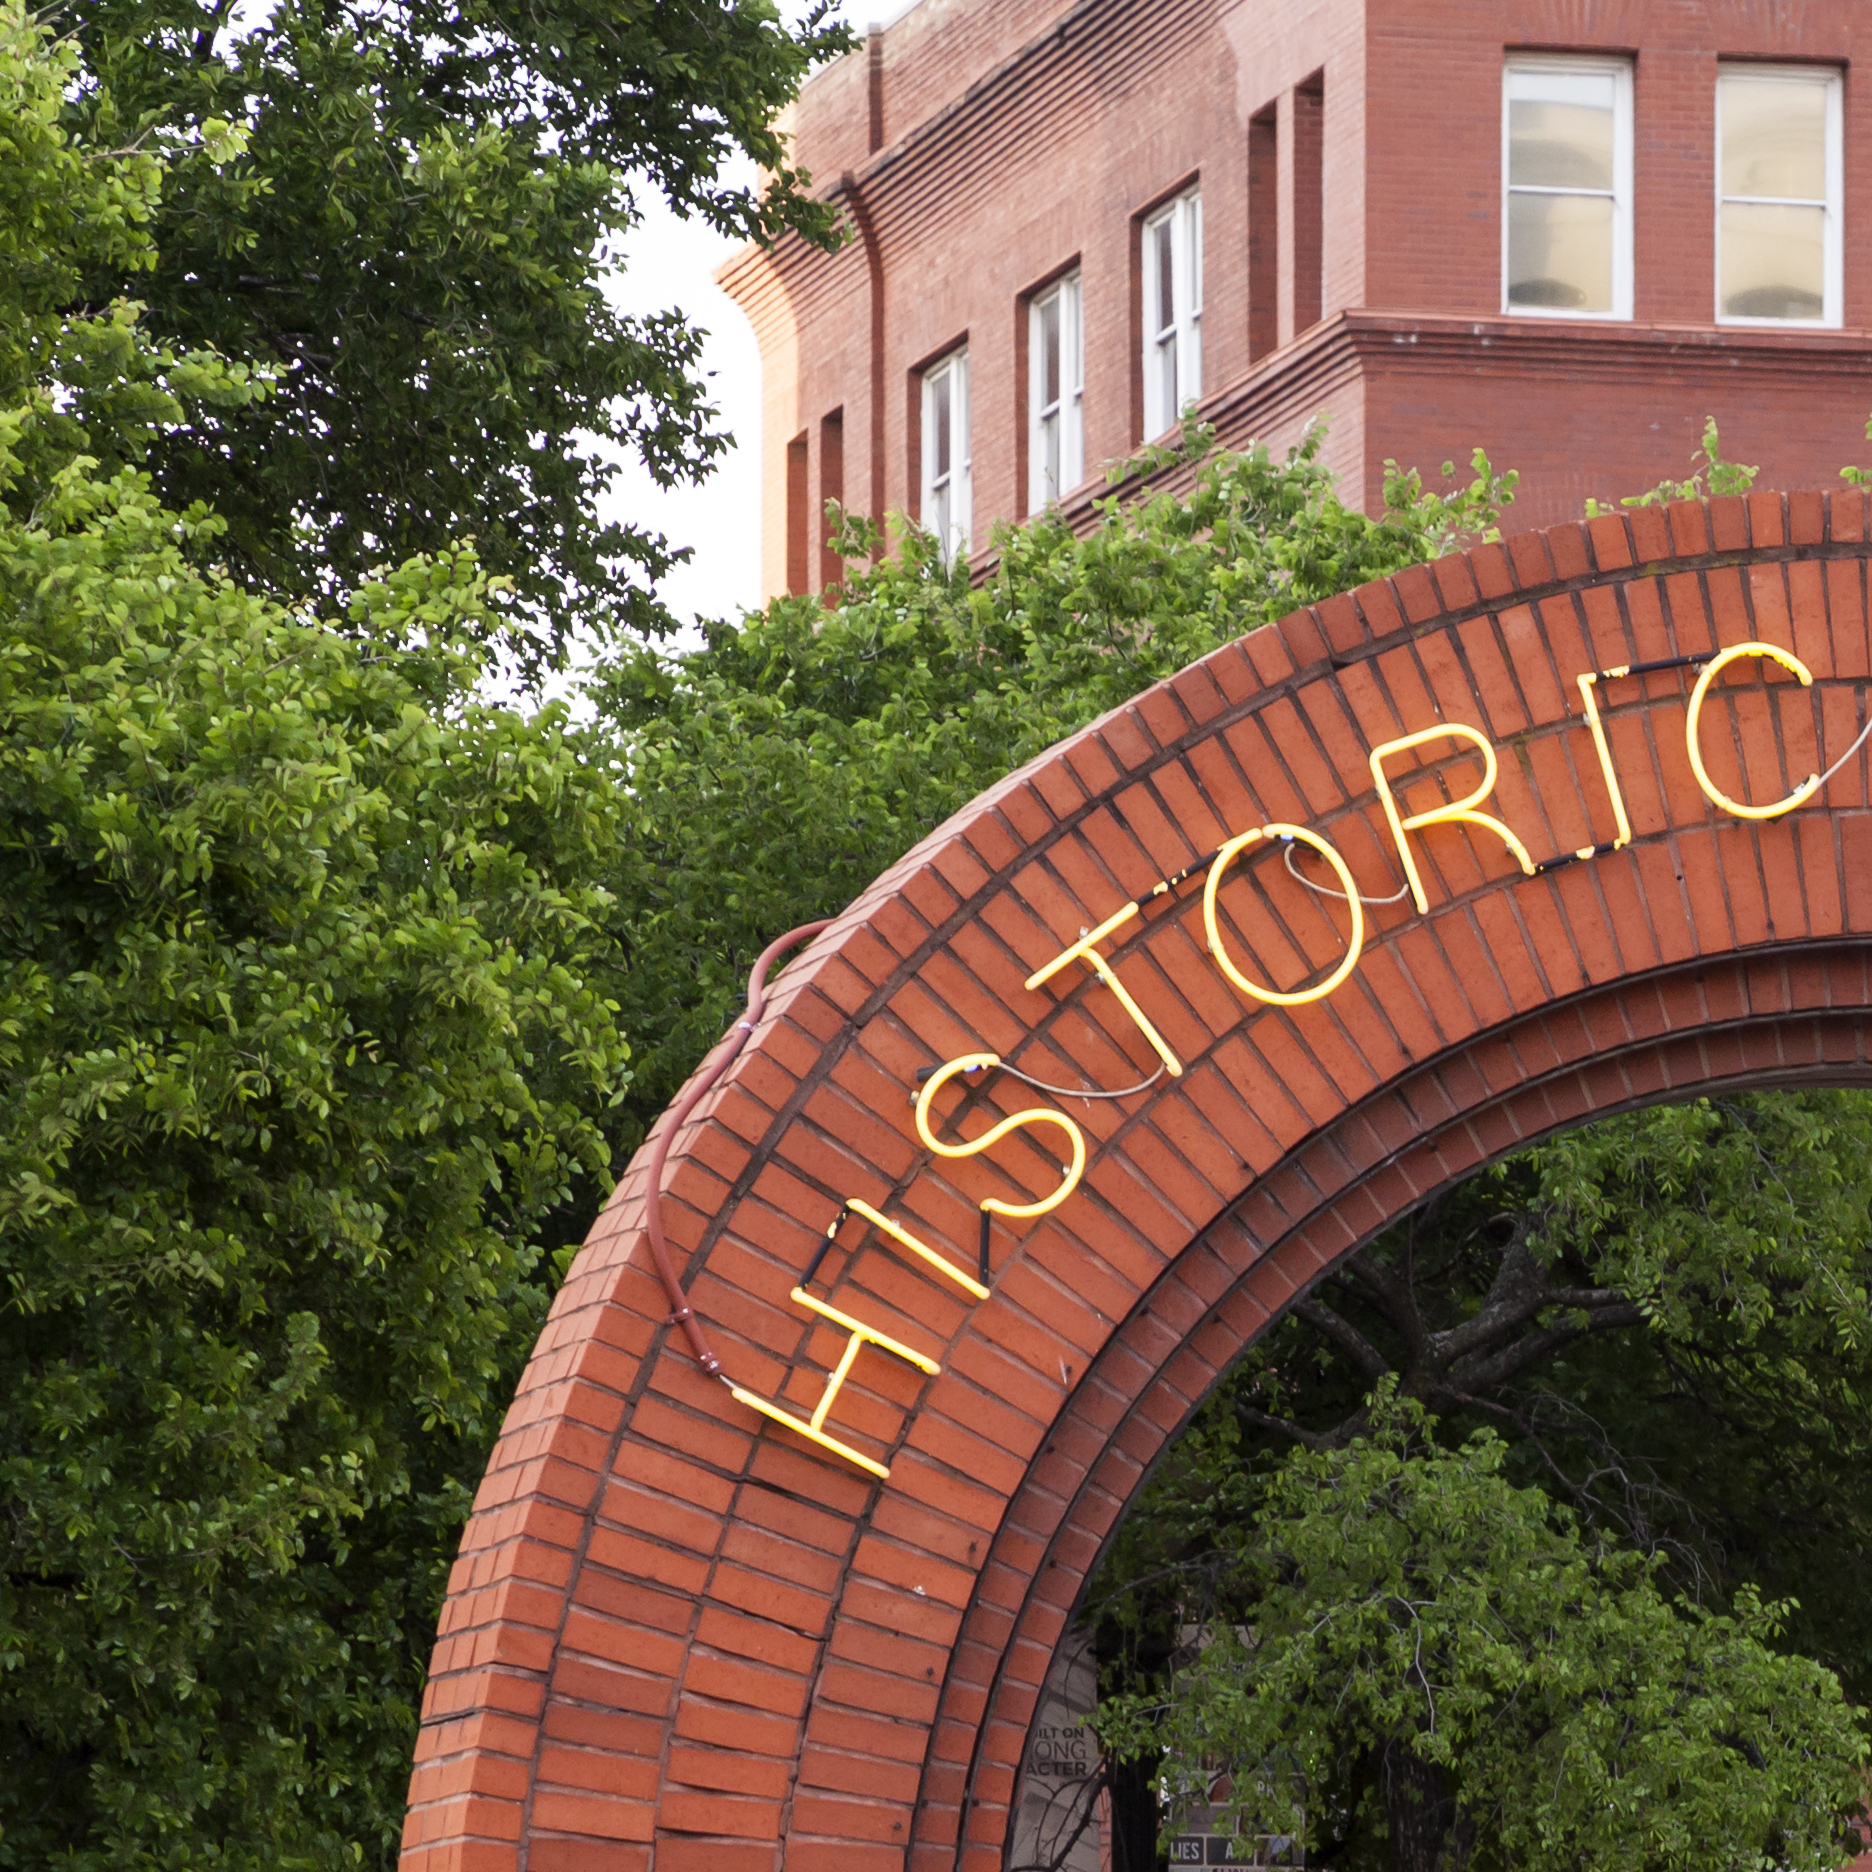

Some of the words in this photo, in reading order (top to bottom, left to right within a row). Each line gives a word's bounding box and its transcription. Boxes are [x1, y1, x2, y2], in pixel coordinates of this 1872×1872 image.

[732, 641, 1813, 1478] HISTORIC
[1062, 1727, 1084, 1739] ON
[1170, 1842, 1200, 1861] LIES
